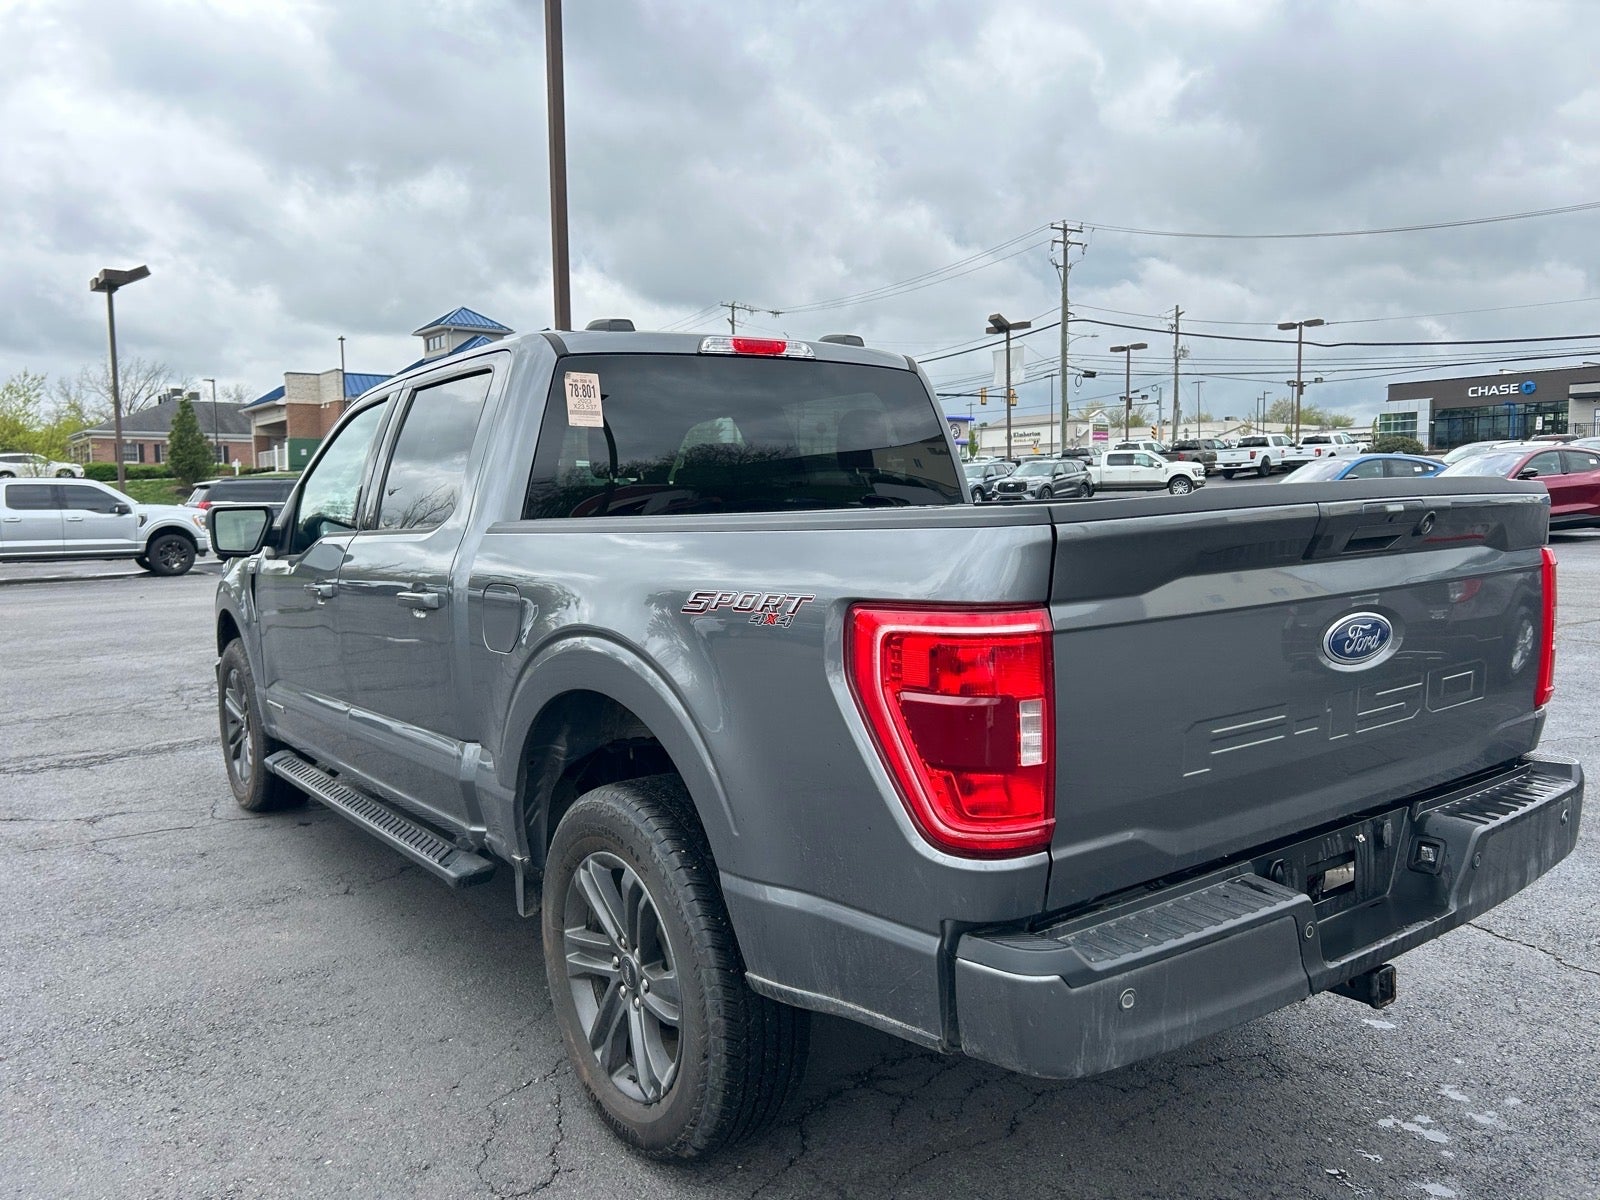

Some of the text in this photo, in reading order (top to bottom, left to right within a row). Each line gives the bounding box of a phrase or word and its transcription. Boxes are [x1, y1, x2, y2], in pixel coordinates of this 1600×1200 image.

[569, 383, 596, 398] 78:801
[1468, 383, 1520, 397] CHASE
[681, 589, 816, 614] SPORT
[1344, 624, 1381, 654] Ford
[1183, 658, 1487, 777] F-150
